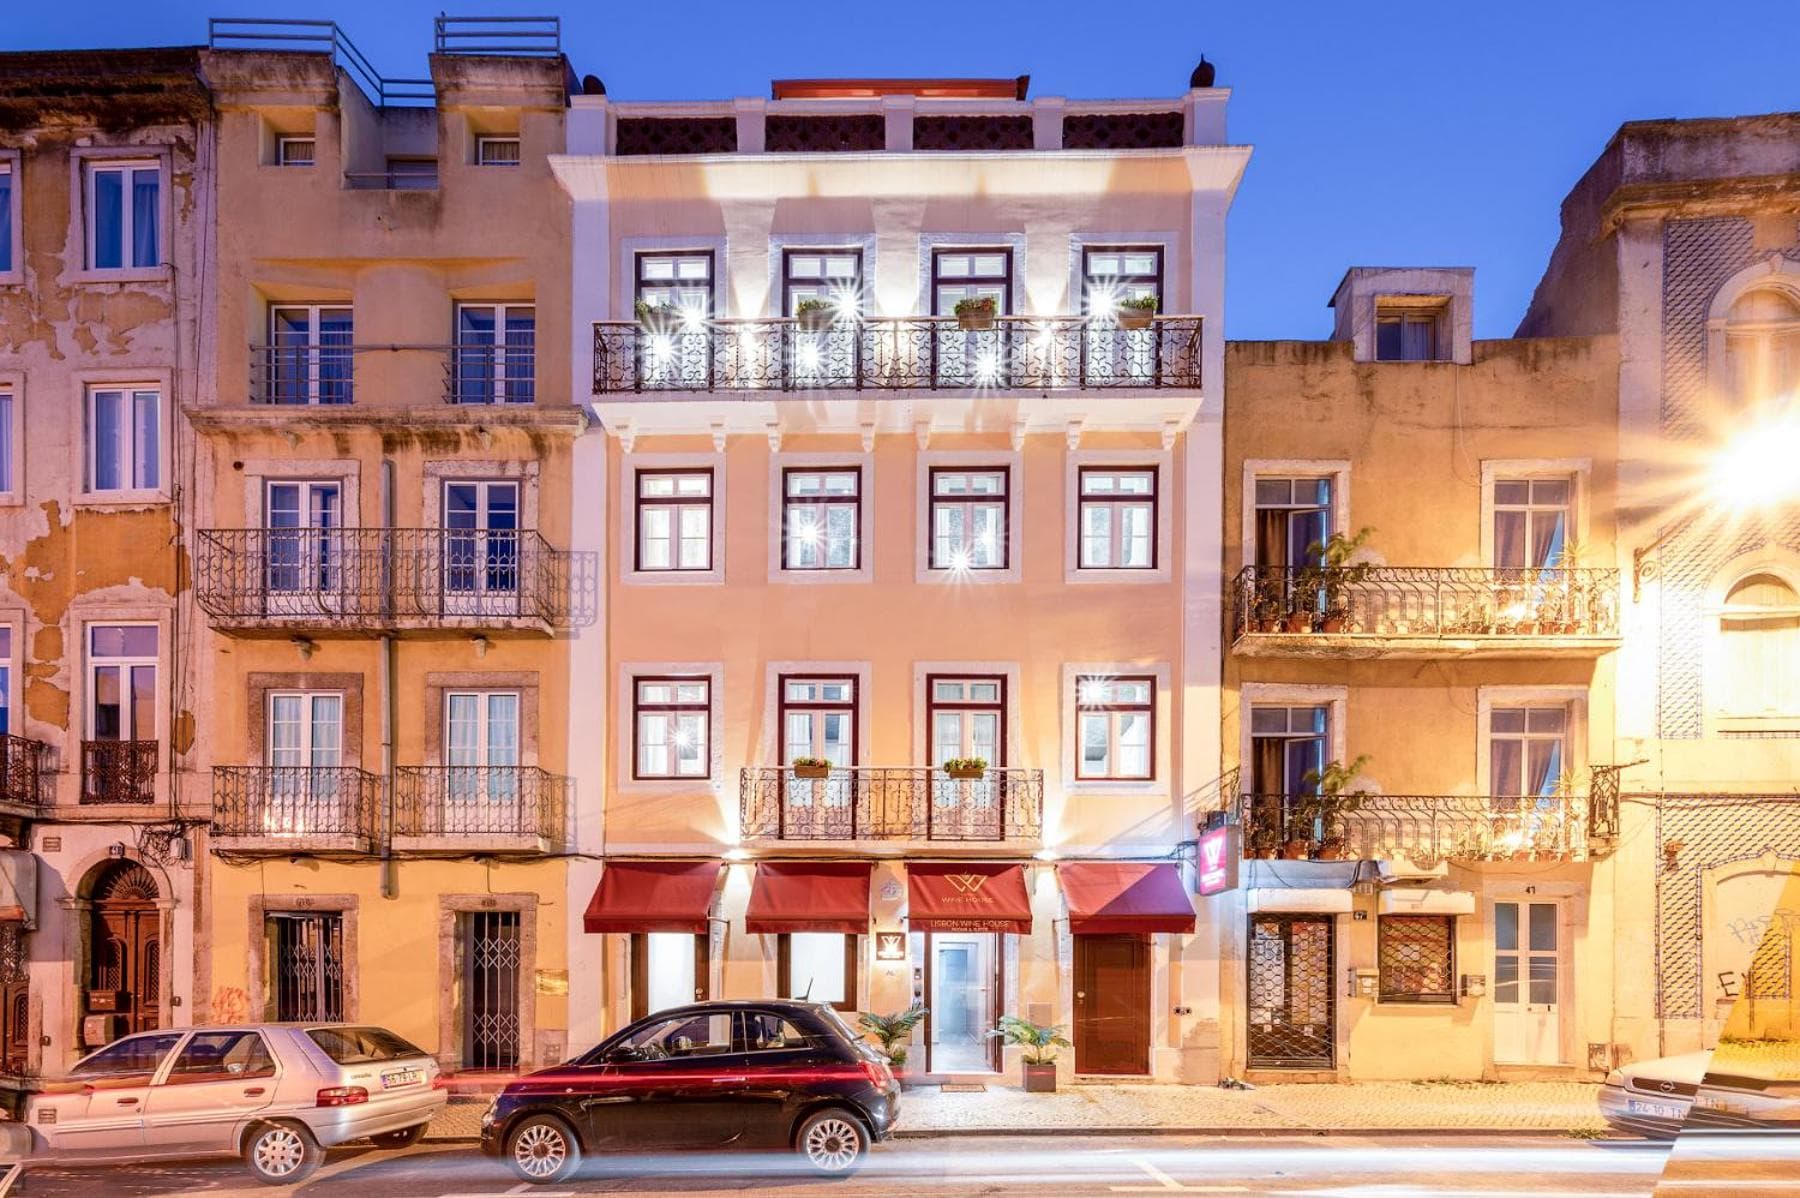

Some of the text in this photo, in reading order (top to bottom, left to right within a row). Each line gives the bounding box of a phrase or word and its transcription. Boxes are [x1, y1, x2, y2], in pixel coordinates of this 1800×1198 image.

[930, 920, 1010, 928] LISBON WINE HOUSE
